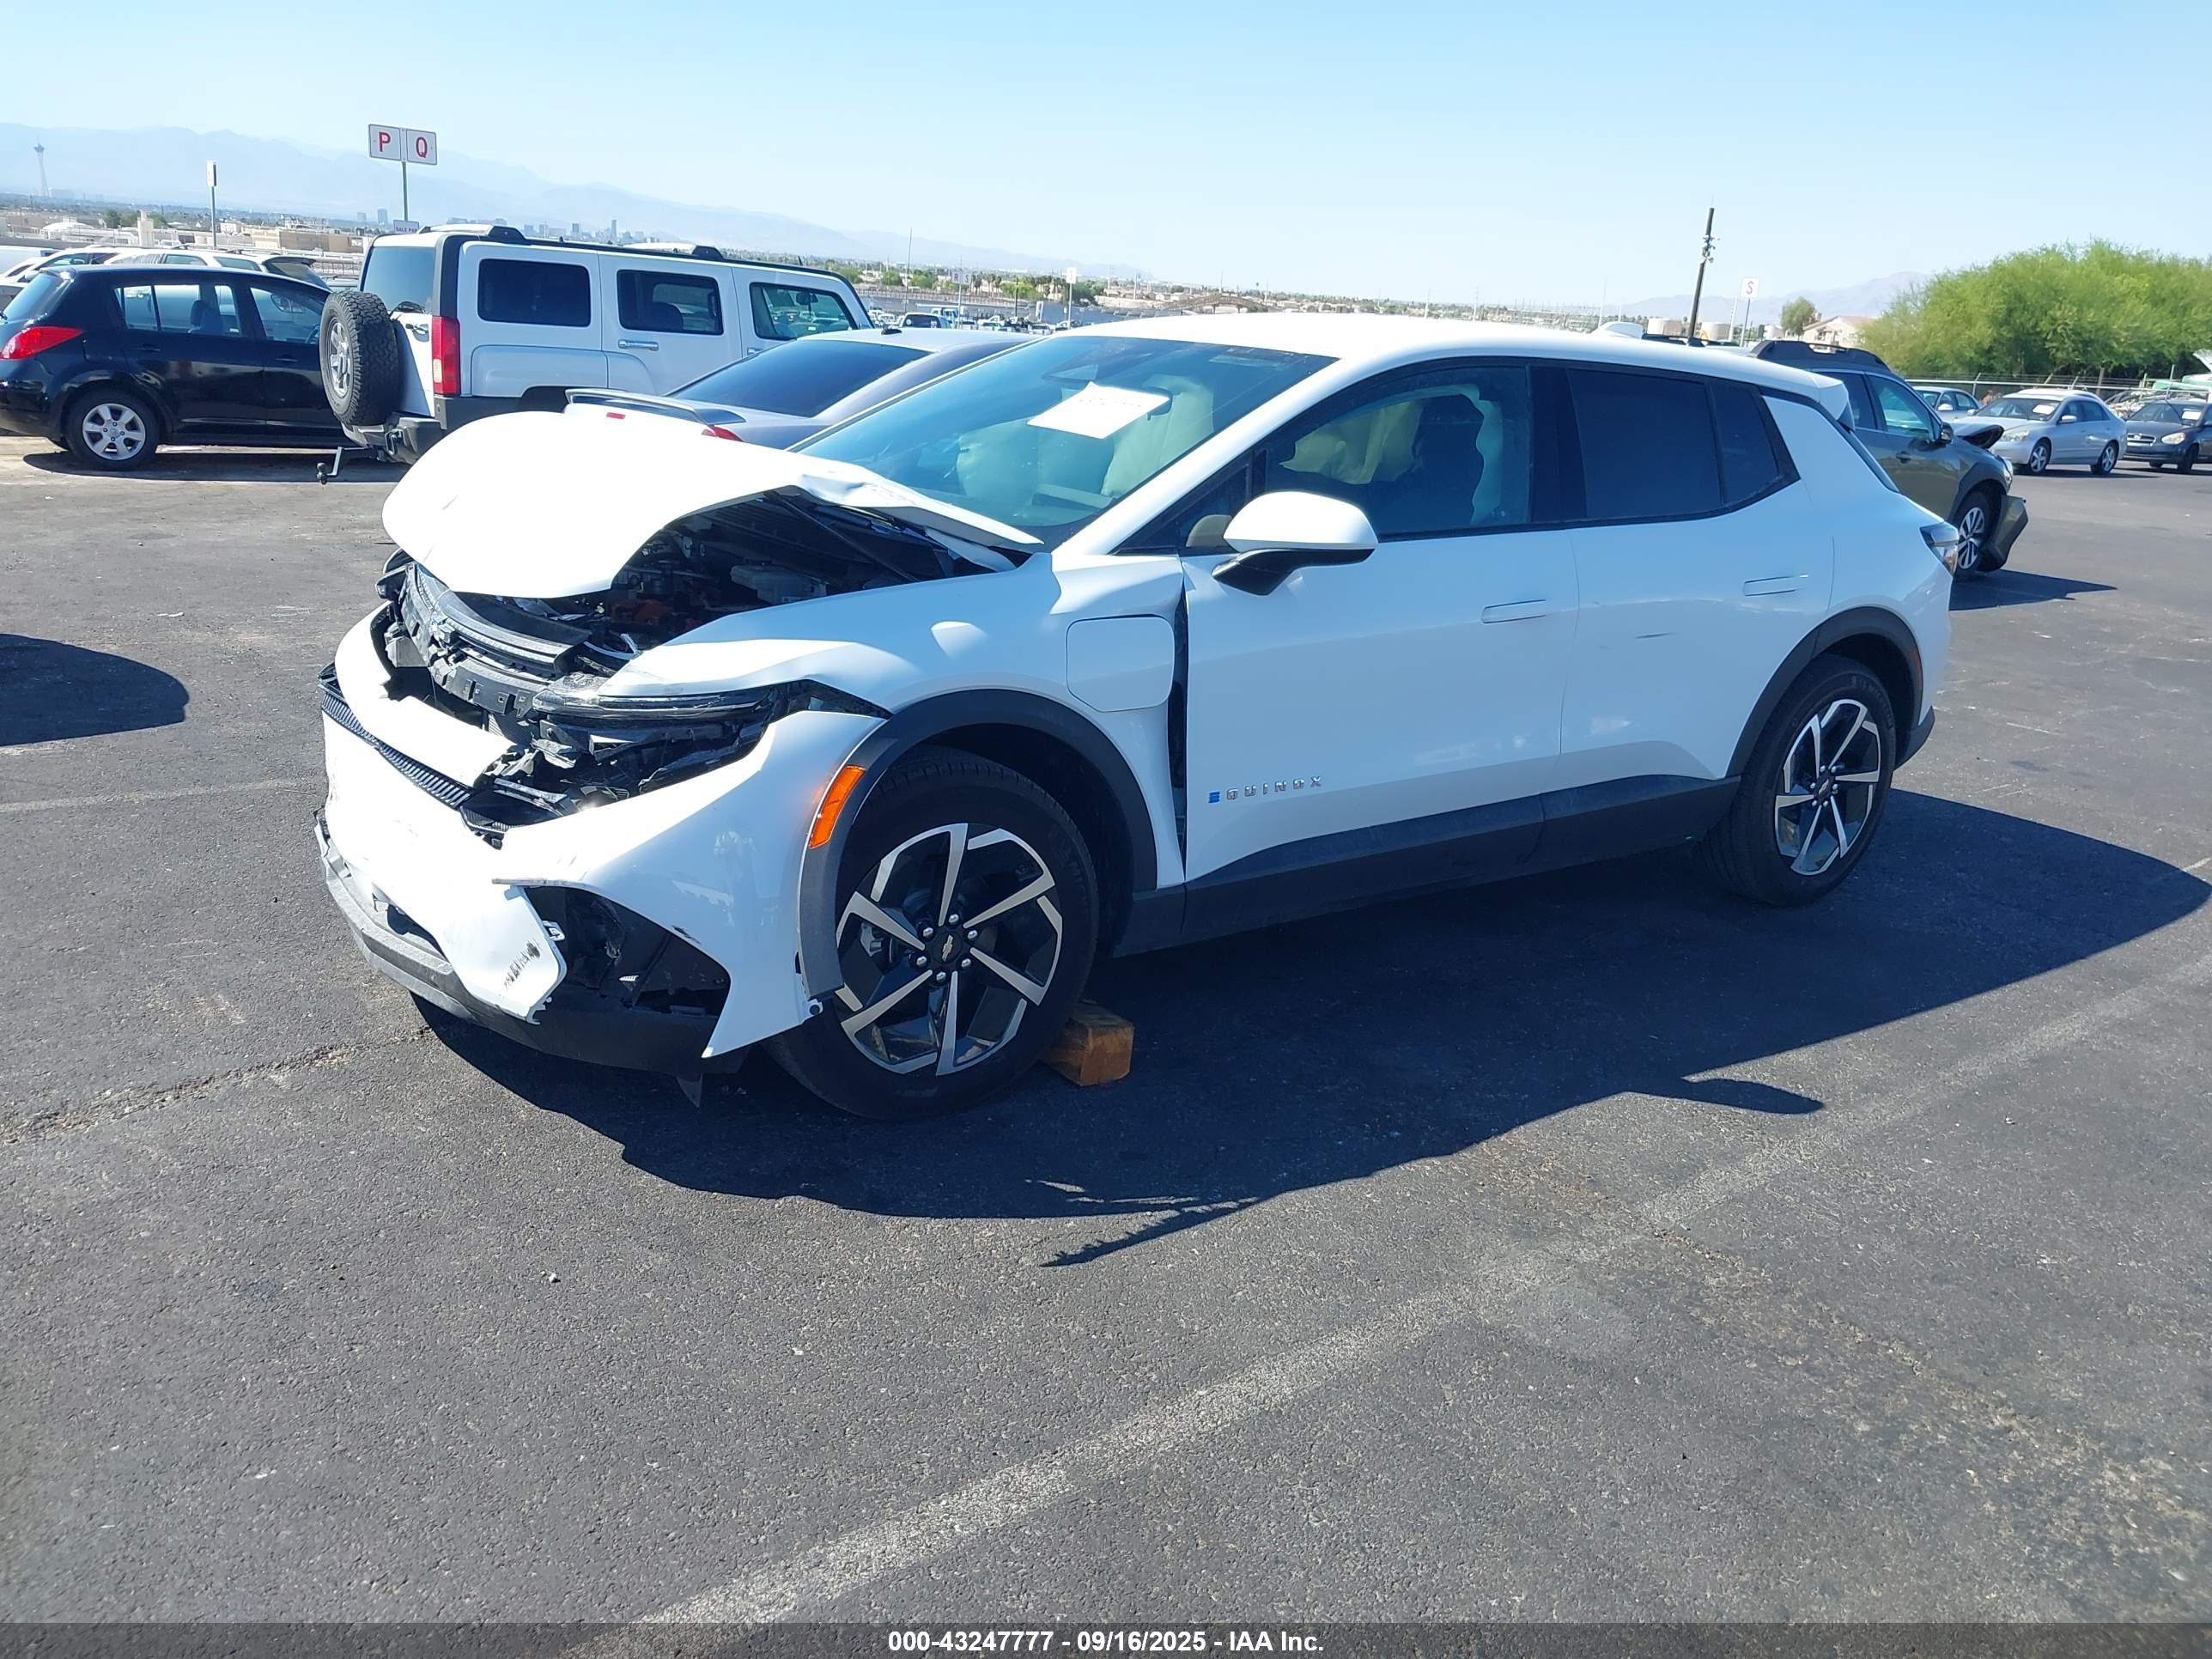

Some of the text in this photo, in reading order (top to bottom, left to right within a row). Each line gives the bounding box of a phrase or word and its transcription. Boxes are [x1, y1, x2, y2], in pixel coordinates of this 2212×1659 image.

[378, 131, 428, 158] P Q
[1746, 281, 1753, 295] S
[1208, 775, 1322, 804] EQUINOX
